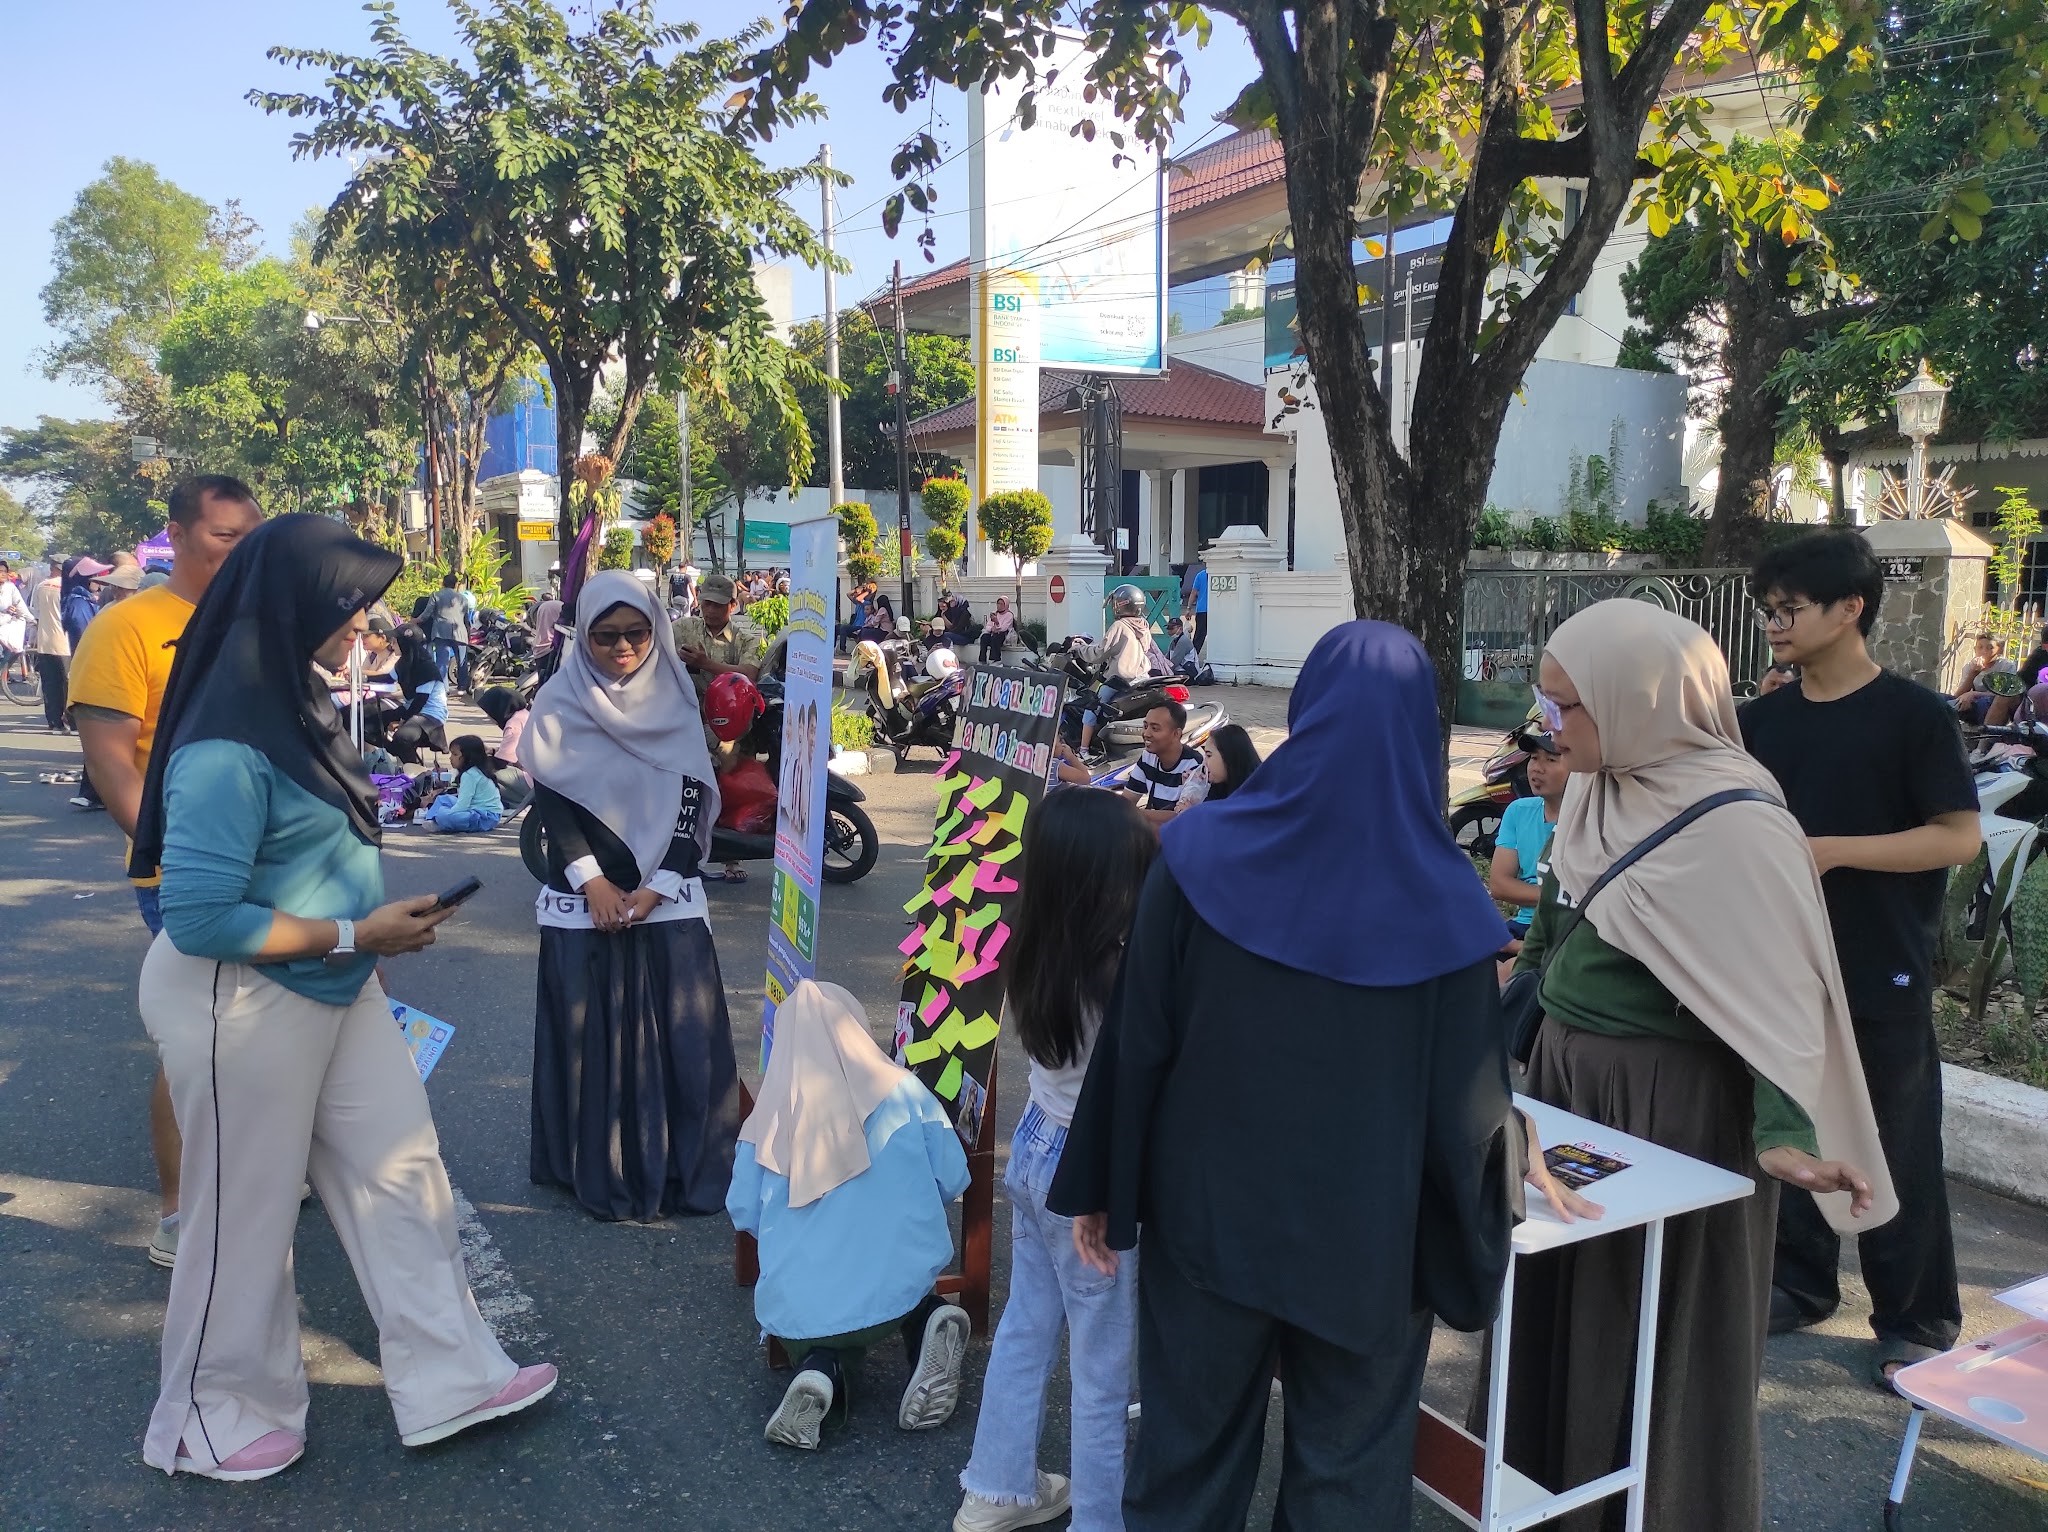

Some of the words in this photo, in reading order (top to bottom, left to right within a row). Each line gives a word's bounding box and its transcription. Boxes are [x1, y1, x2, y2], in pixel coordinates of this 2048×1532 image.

[1410, 256, 1425, 269] BSI
[994, 293, 1020, 312] BSI
[993, 347, 1017, 363] BSI
[994, 413, 1018, 424] ATM
[1889, 563, 1911, 575] 292
[1211, 576, 1237, 590] 294
[972, 671, 1058, 719] Kicaukan
[952, 715, 1050, 780] Masalahmu
[1989, 828, 2022, 838] HONDA
[418, 1046, 438, 1078] UNIVER
